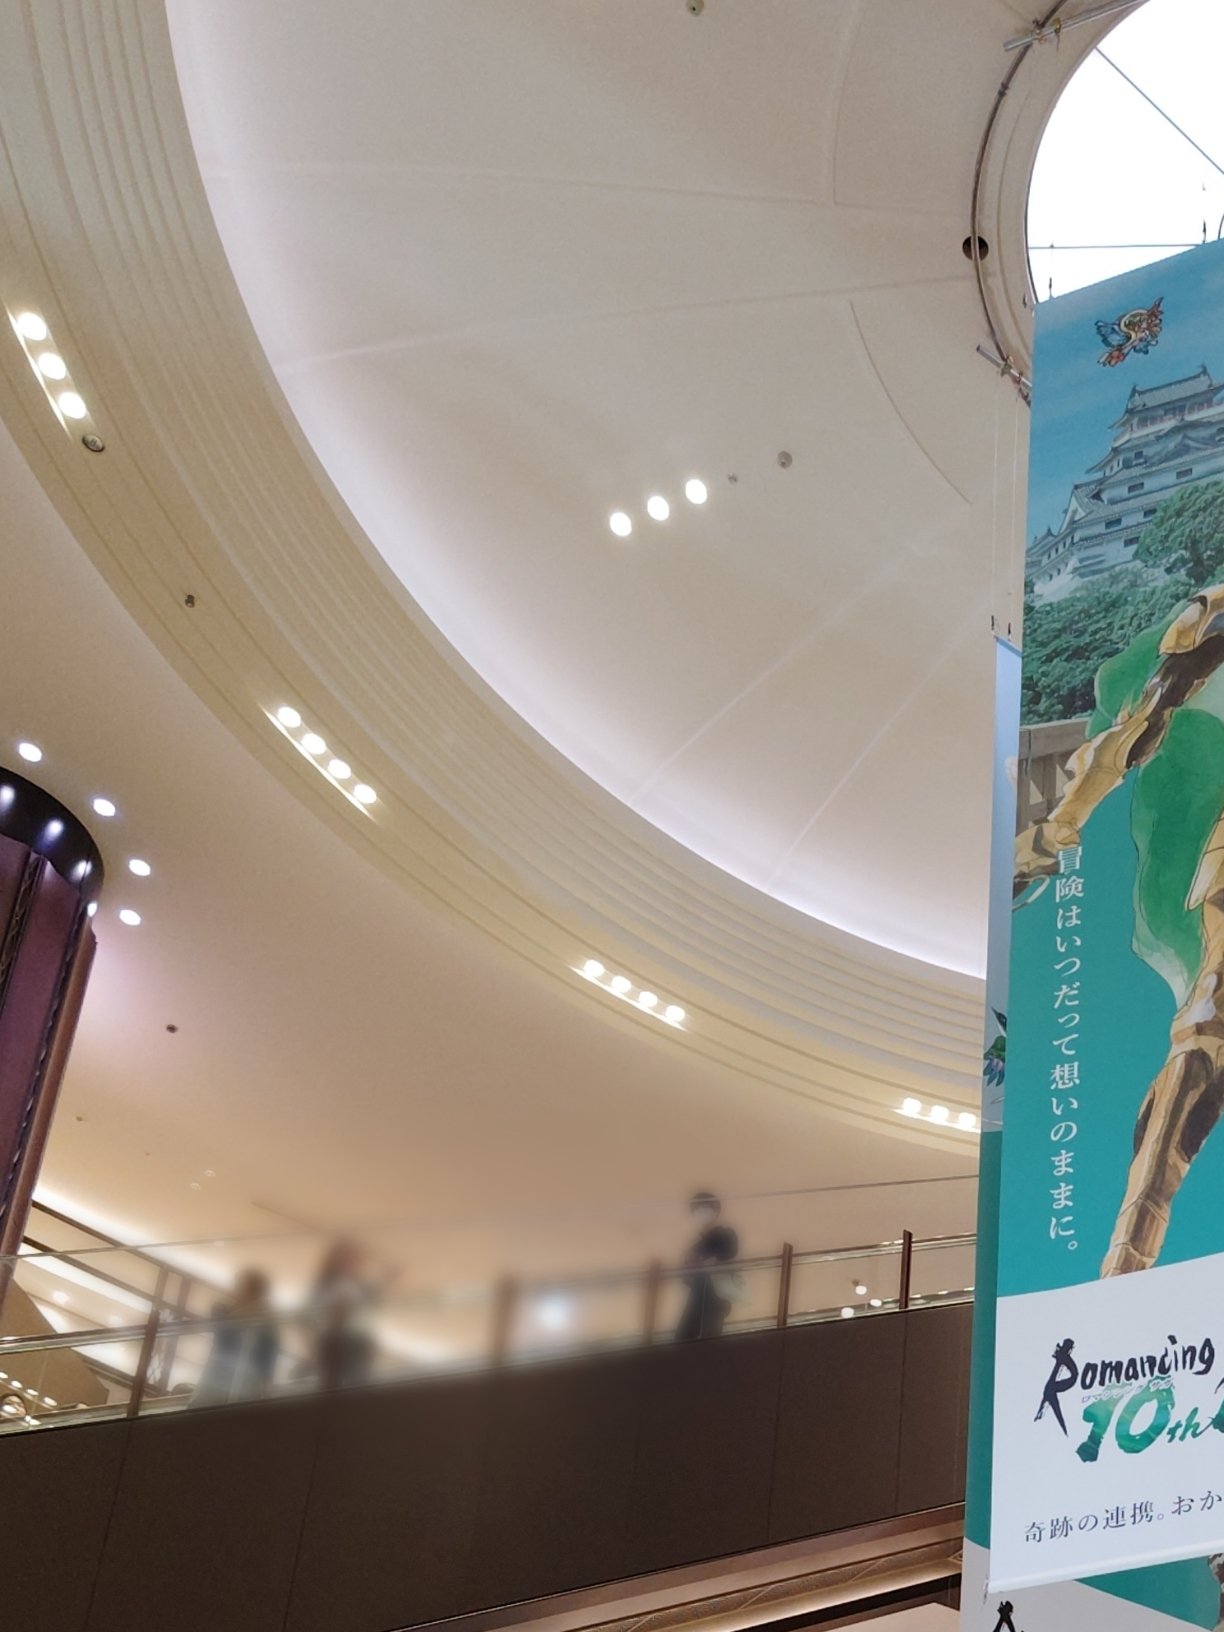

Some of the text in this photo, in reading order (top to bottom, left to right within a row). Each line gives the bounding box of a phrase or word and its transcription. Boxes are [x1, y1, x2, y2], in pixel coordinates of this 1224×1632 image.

[1049, 846, 1085, 1252] 冒険はいつだって想いのままに。
[1034, 1335, 1215, 1437] Romancing
